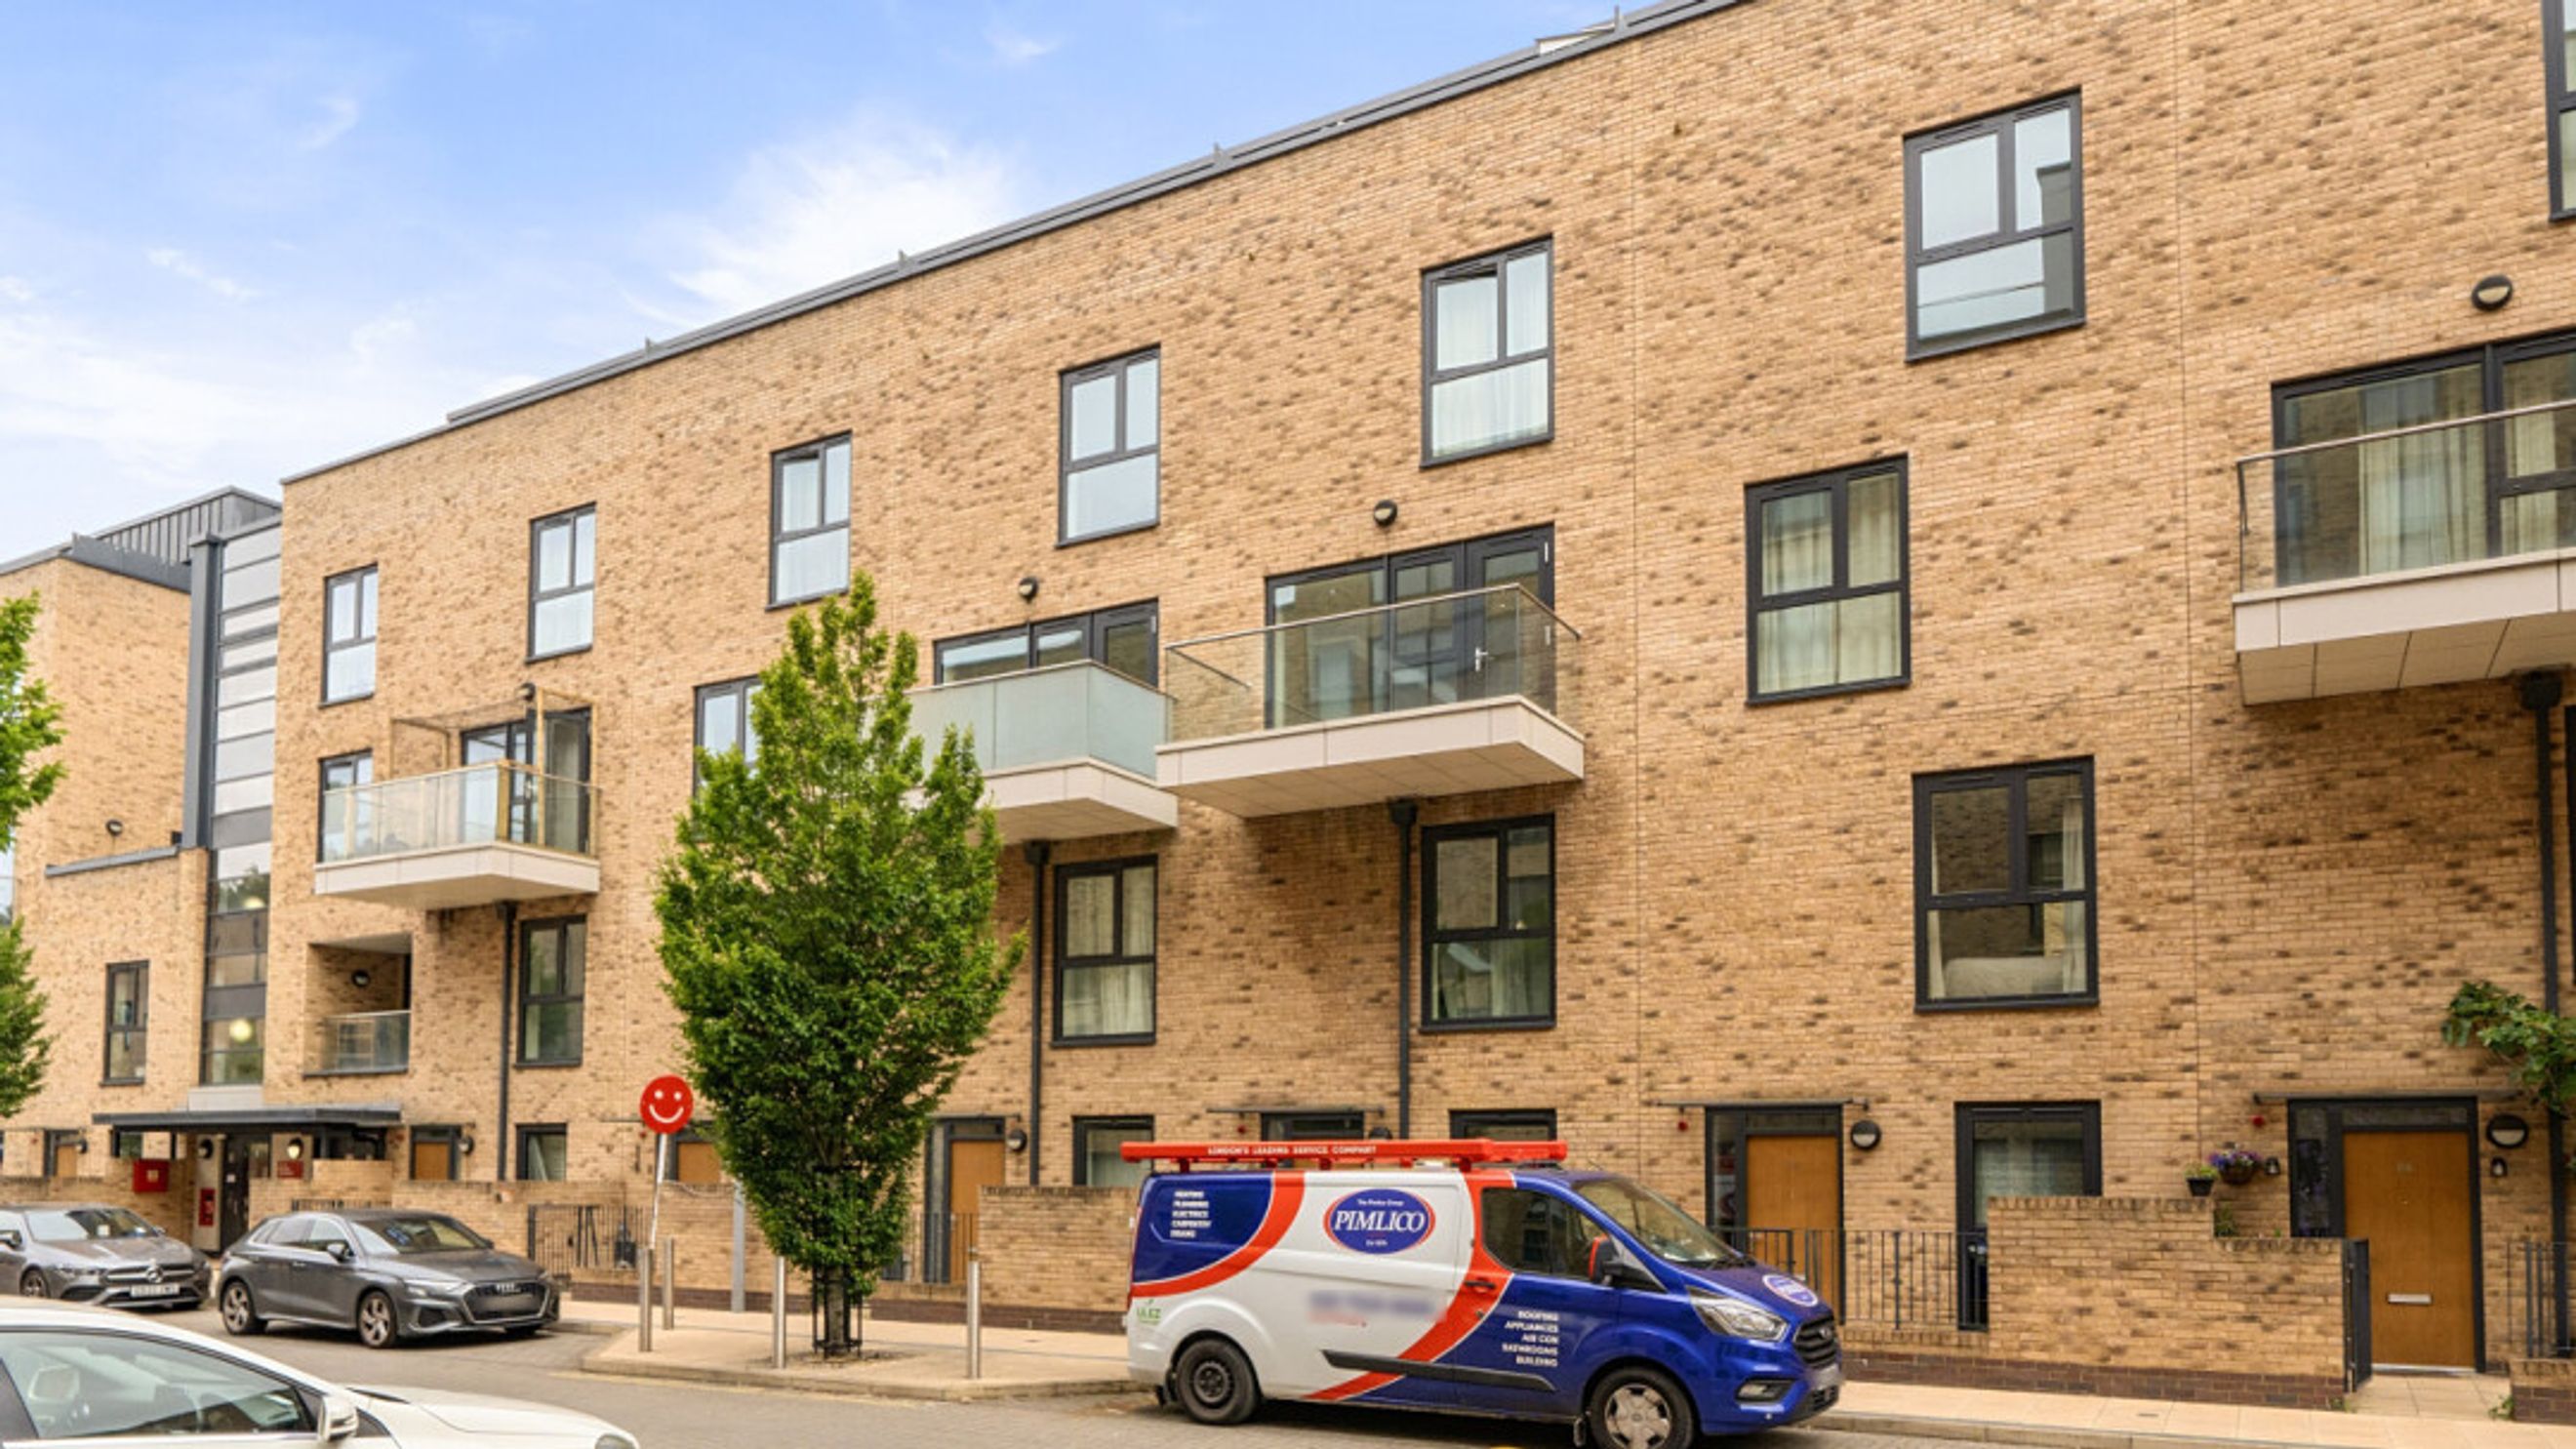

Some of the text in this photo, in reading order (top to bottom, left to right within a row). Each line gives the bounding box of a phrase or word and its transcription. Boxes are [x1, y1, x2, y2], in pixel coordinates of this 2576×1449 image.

[1293, 1146, 1328, 1154] SERVICE
[1332, 1146, 1377, 1154] COMPANY
[1334, 1210, 1426, 1232] PIMLICO
[1517, 1309, 1559, 1321] ROOFING
[1504, 1320, 1559, 1333] APPLIANCES
[1521, 1333, 1559, 1345] AIR CON
[1502, 1343, 1558, 1356] BATHROOMS
[1515, 1355, 1558, 1367] BUILDING
